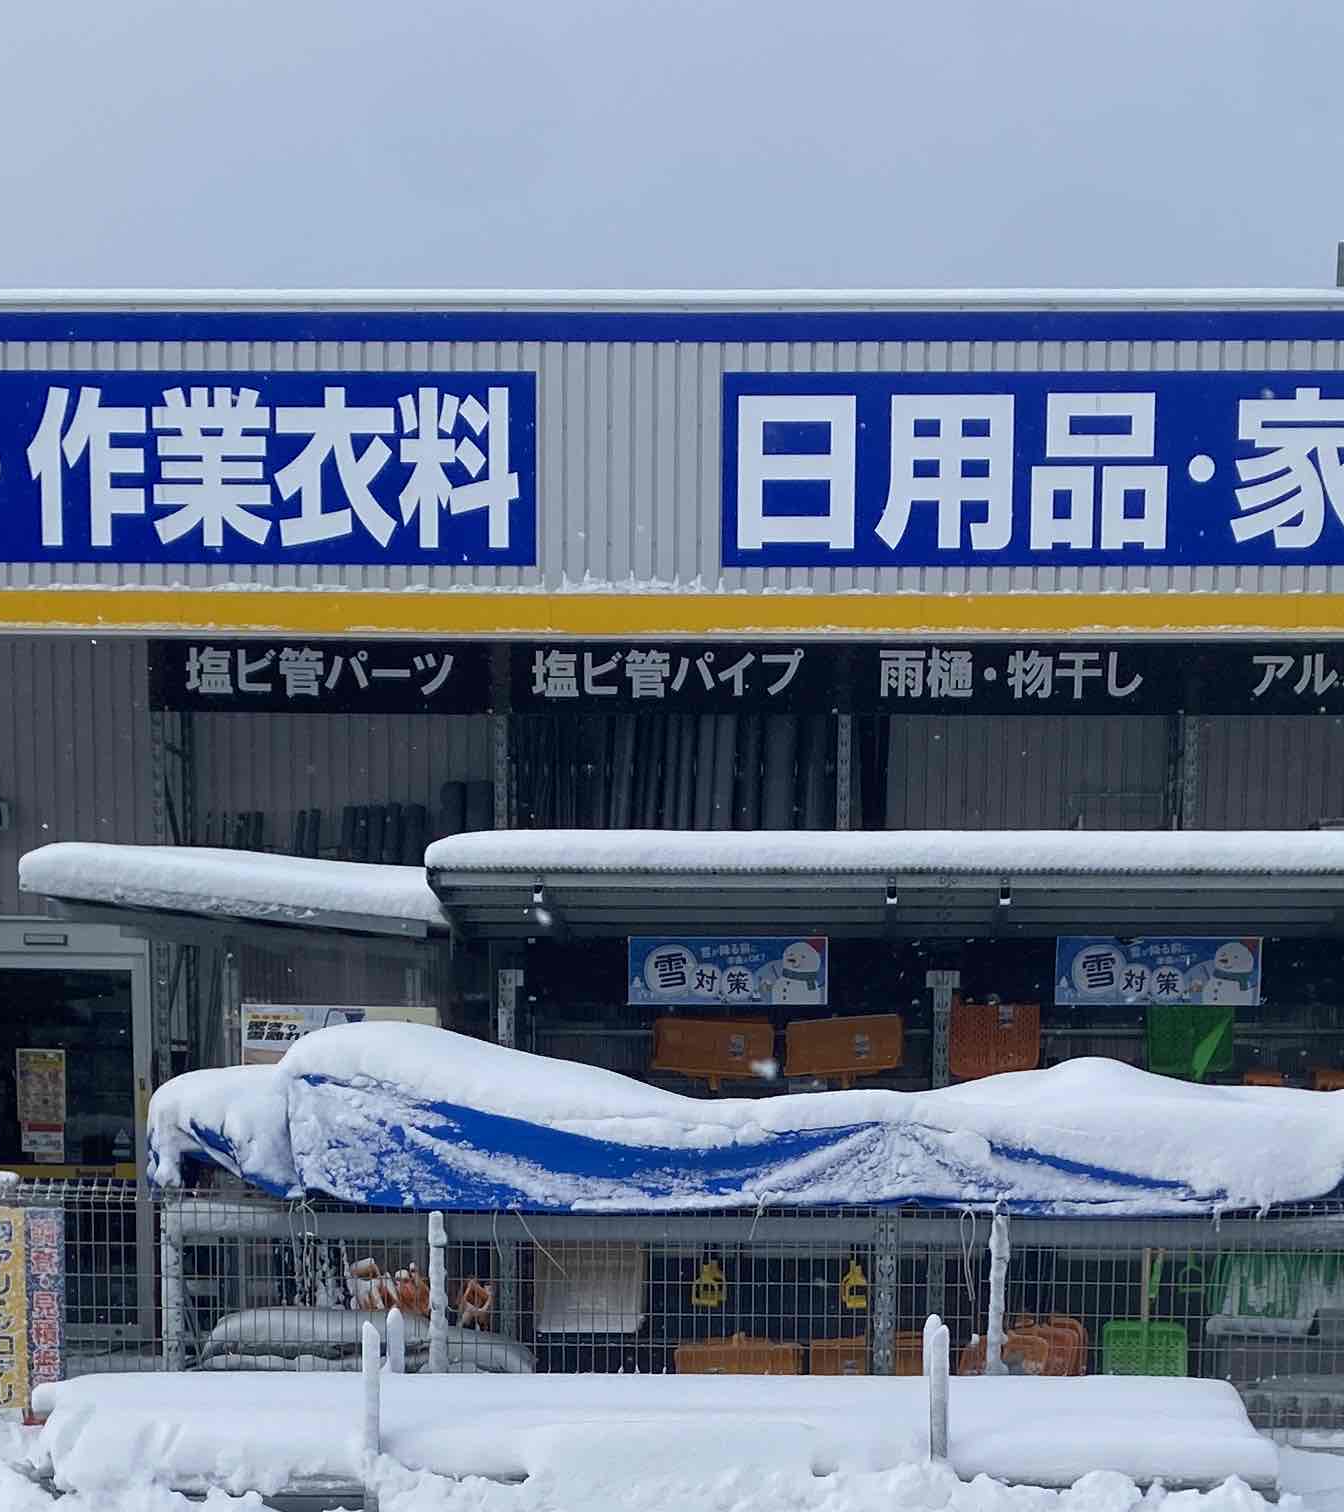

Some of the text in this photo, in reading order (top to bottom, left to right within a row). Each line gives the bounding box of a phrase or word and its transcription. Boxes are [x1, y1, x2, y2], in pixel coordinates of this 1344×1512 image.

[185, 647, 455, 698] 塩ビ管パーツ
[532, 648, 805, 699] 塩ビ管パイプ
[879, 648, 1144, 699] 雨樋・物干し
[654, 952, 751, 995] 雪対策
[1082, 951, 1180, 995] 雪対策
